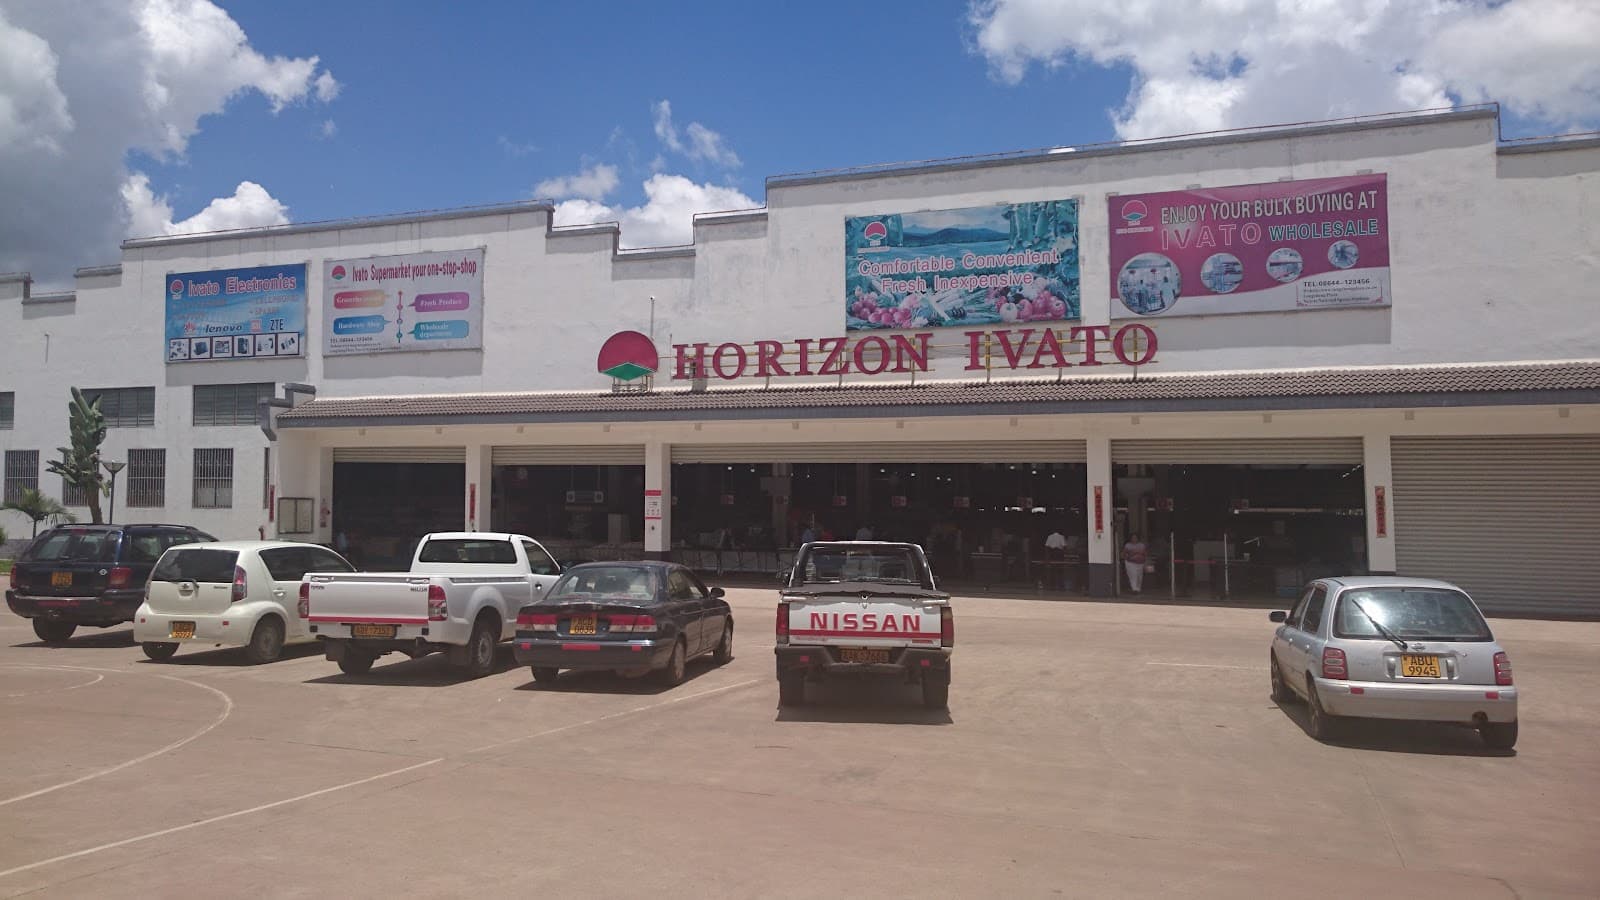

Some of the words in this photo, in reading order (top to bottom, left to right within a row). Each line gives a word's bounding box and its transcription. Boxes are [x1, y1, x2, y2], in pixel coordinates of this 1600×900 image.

[1161, 205, 1207, 224] ENJOY
[1210, 201, 1251, 220] YOUR
[1254, 198, 1292, 217] BULK
[1295, 193, 1353, 213] BUYING
[1358, 190, 1377, 210] AT
[1161, 223, 1262, 250] IVATO
[1268, 219, 1379, 242] WHOLESALE
[352, 265, 368, 282] Ivato
[370, 262, 411, 284] Supermarket
[412, 266, 426, 281] your
[427, 257, 477, 278] one-stop-shop
[859, 256, 955, 275] Comfortable
[962, 249, 1059, 269] Convenient
[188, 279, 220, 297] Ivato
[226, 273, 297, 294] Electronics
[880, 277, 926, 293] Fresh
[935, 270, 1034, 292] Inexpensive
[205, 324, 242, 334] lenovo
[270, 319, 284, 331] ZTE
[672, 333, 933, 380] HORIZON
[964, 323, 1158, 370] IVATO
[810, 612, 921, 632] NISSAN
[1408, 666, 1437, 676] 9945
[1409, 655, 1433, 666] ABU
